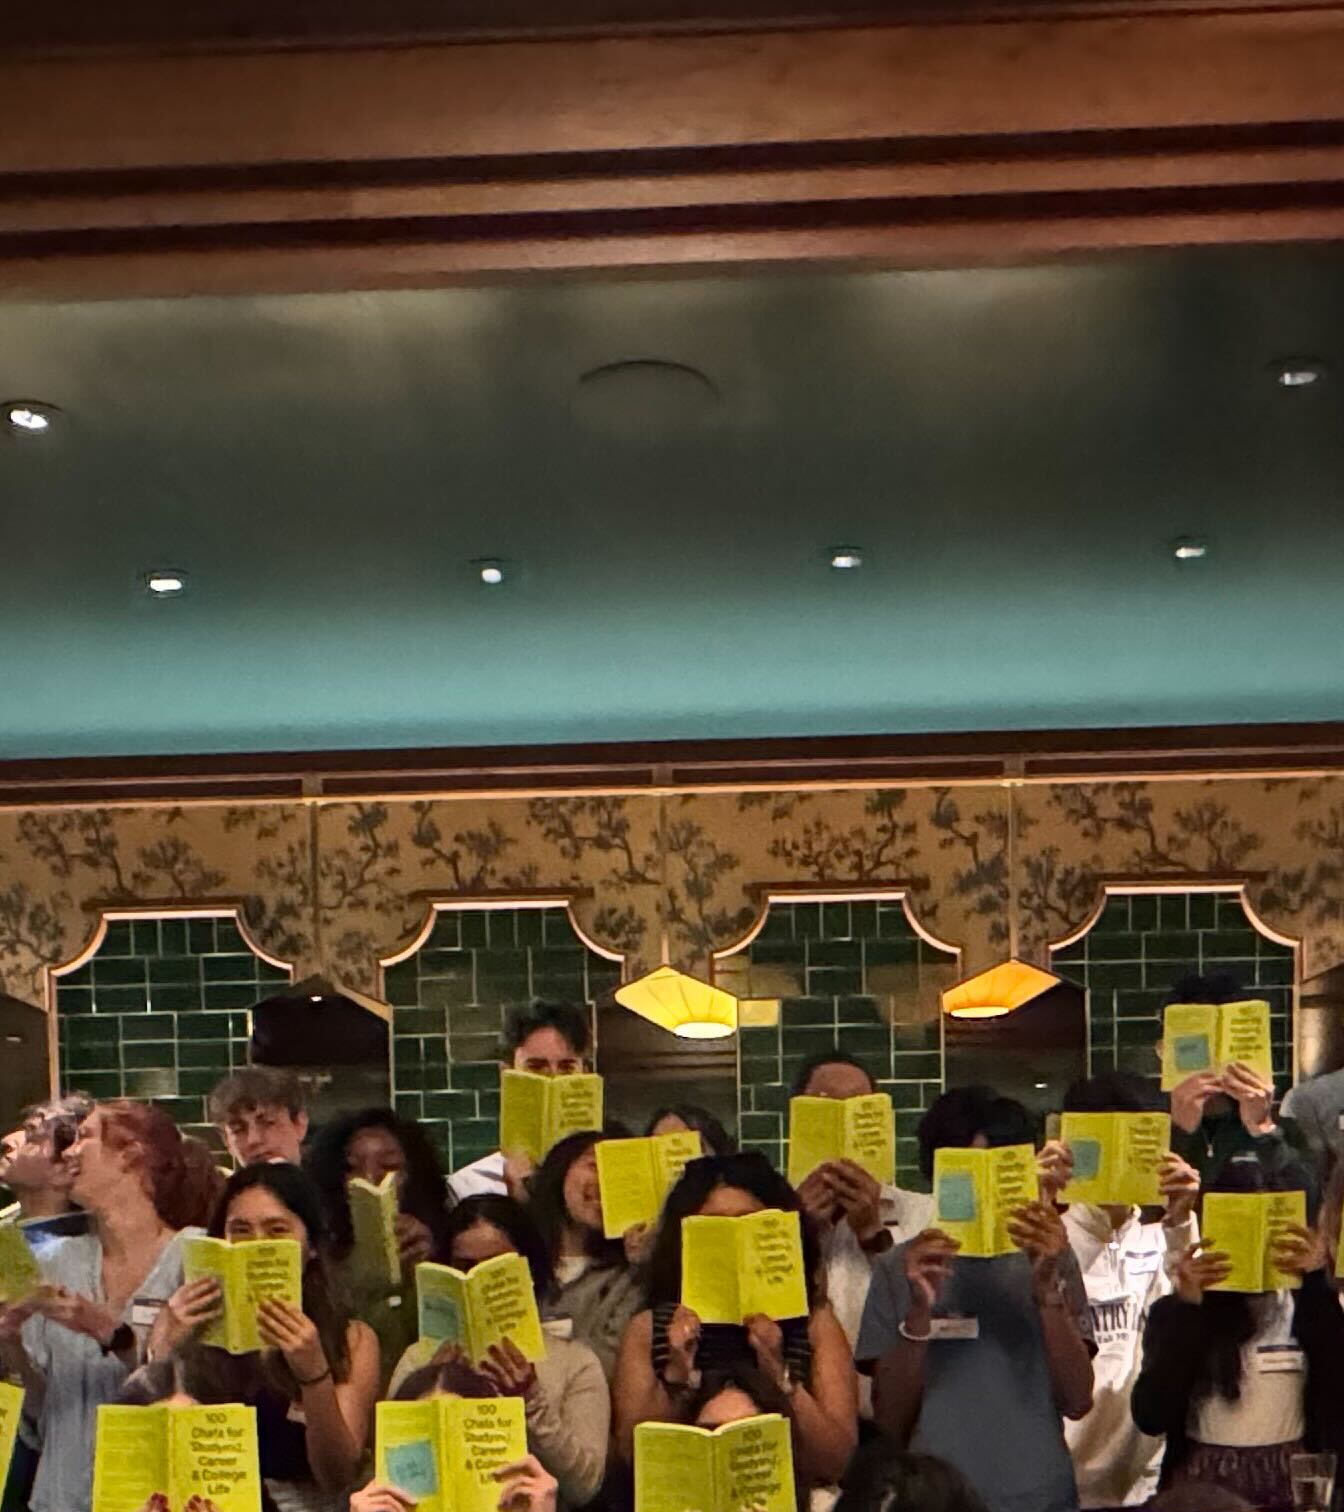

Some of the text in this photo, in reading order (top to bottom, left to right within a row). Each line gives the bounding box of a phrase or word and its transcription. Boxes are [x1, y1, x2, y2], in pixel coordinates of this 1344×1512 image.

[476, 1403, 497, 1415] 100
[463, 1416, 512, 1430] Chats for
[470, 1445, 507, 1456] Career
[197, 1455, 237, 1467] Career
[202, 1468, 247, 1483] College
[207, 1484, 231, 1495] Life
